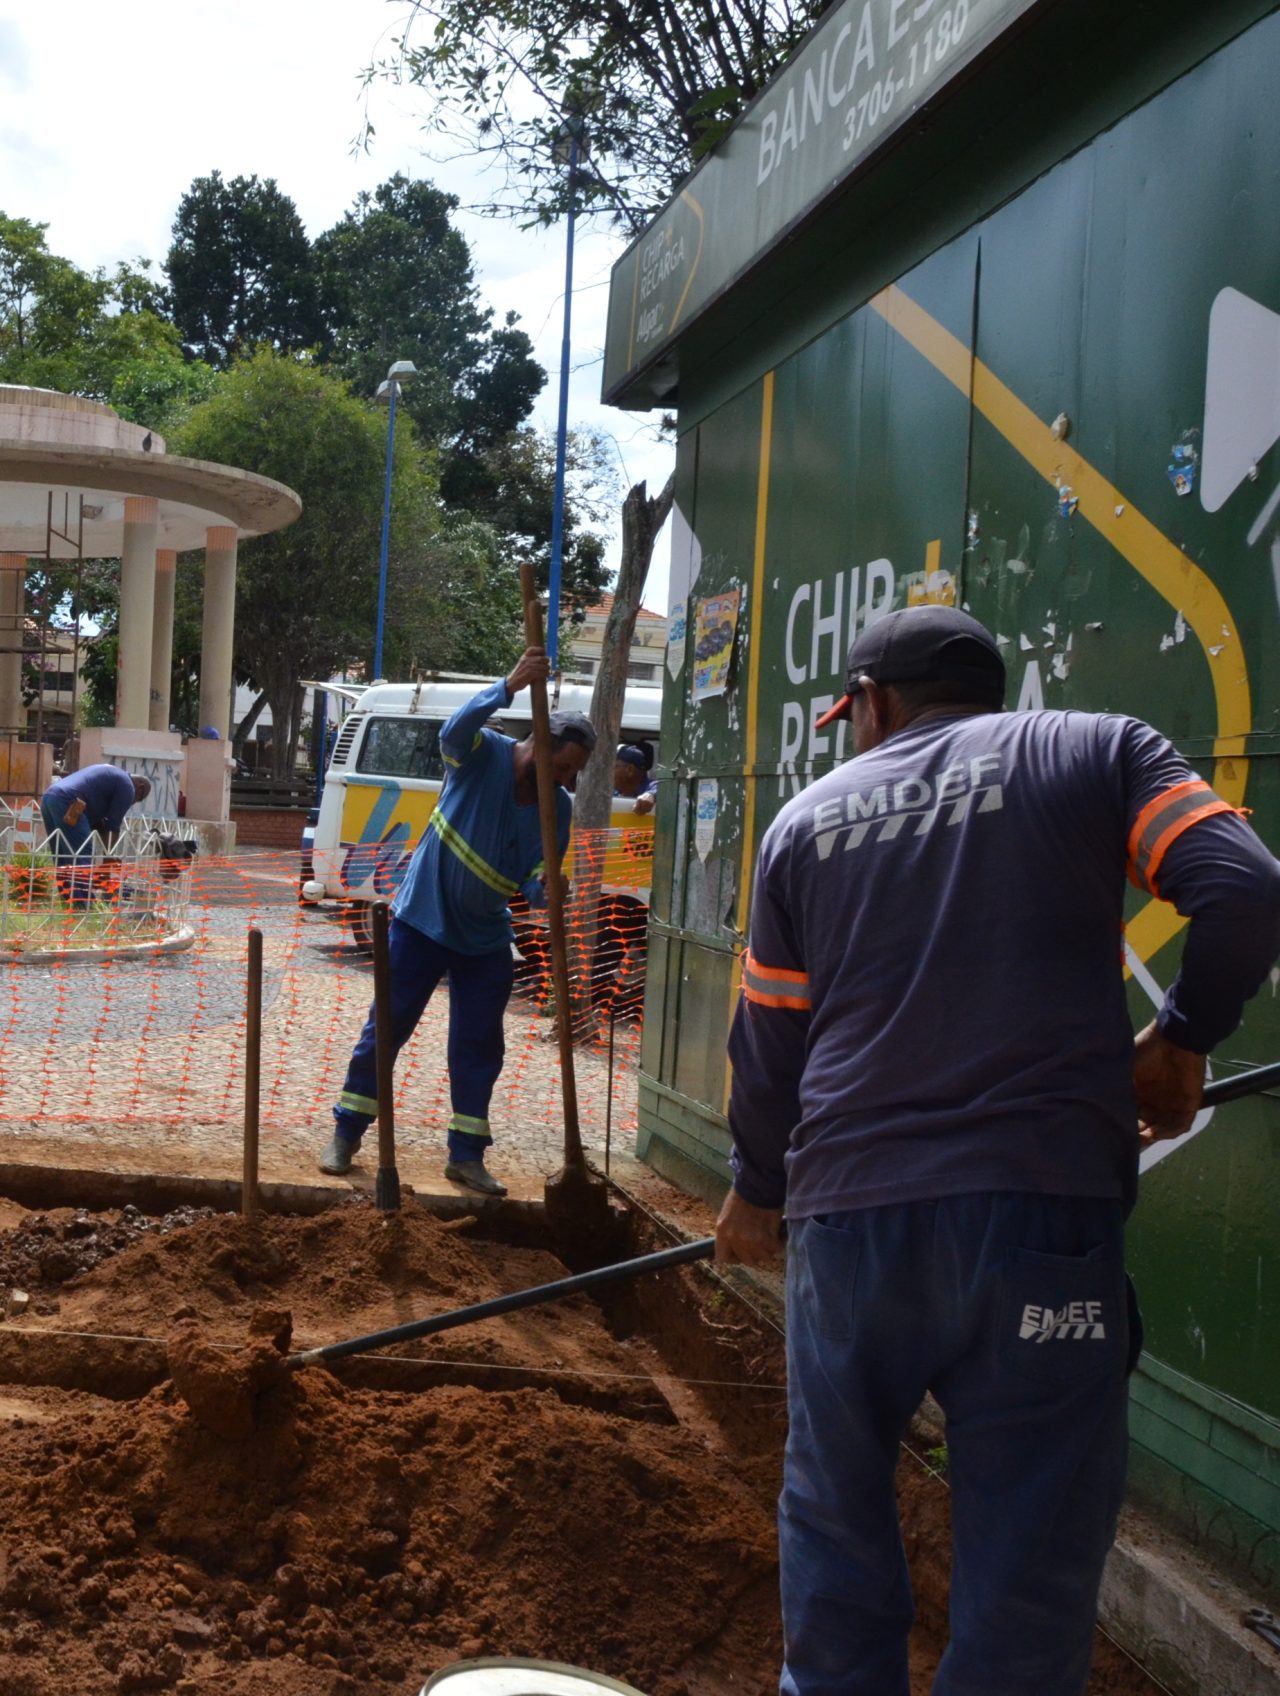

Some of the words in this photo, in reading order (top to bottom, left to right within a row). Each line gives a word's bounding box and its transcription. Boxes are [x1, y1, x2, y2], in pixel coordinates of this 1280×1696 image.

[757, 0, 875, 187] BANCA
[842, 0, 969, 151] 3706-1180
[640, 235, 685, 303] RECARGA
[642, 230, 665, 273] CHIP
[785, 558, 895, 686] CHIP
[814, 752, 1002, 833] EMDEF
